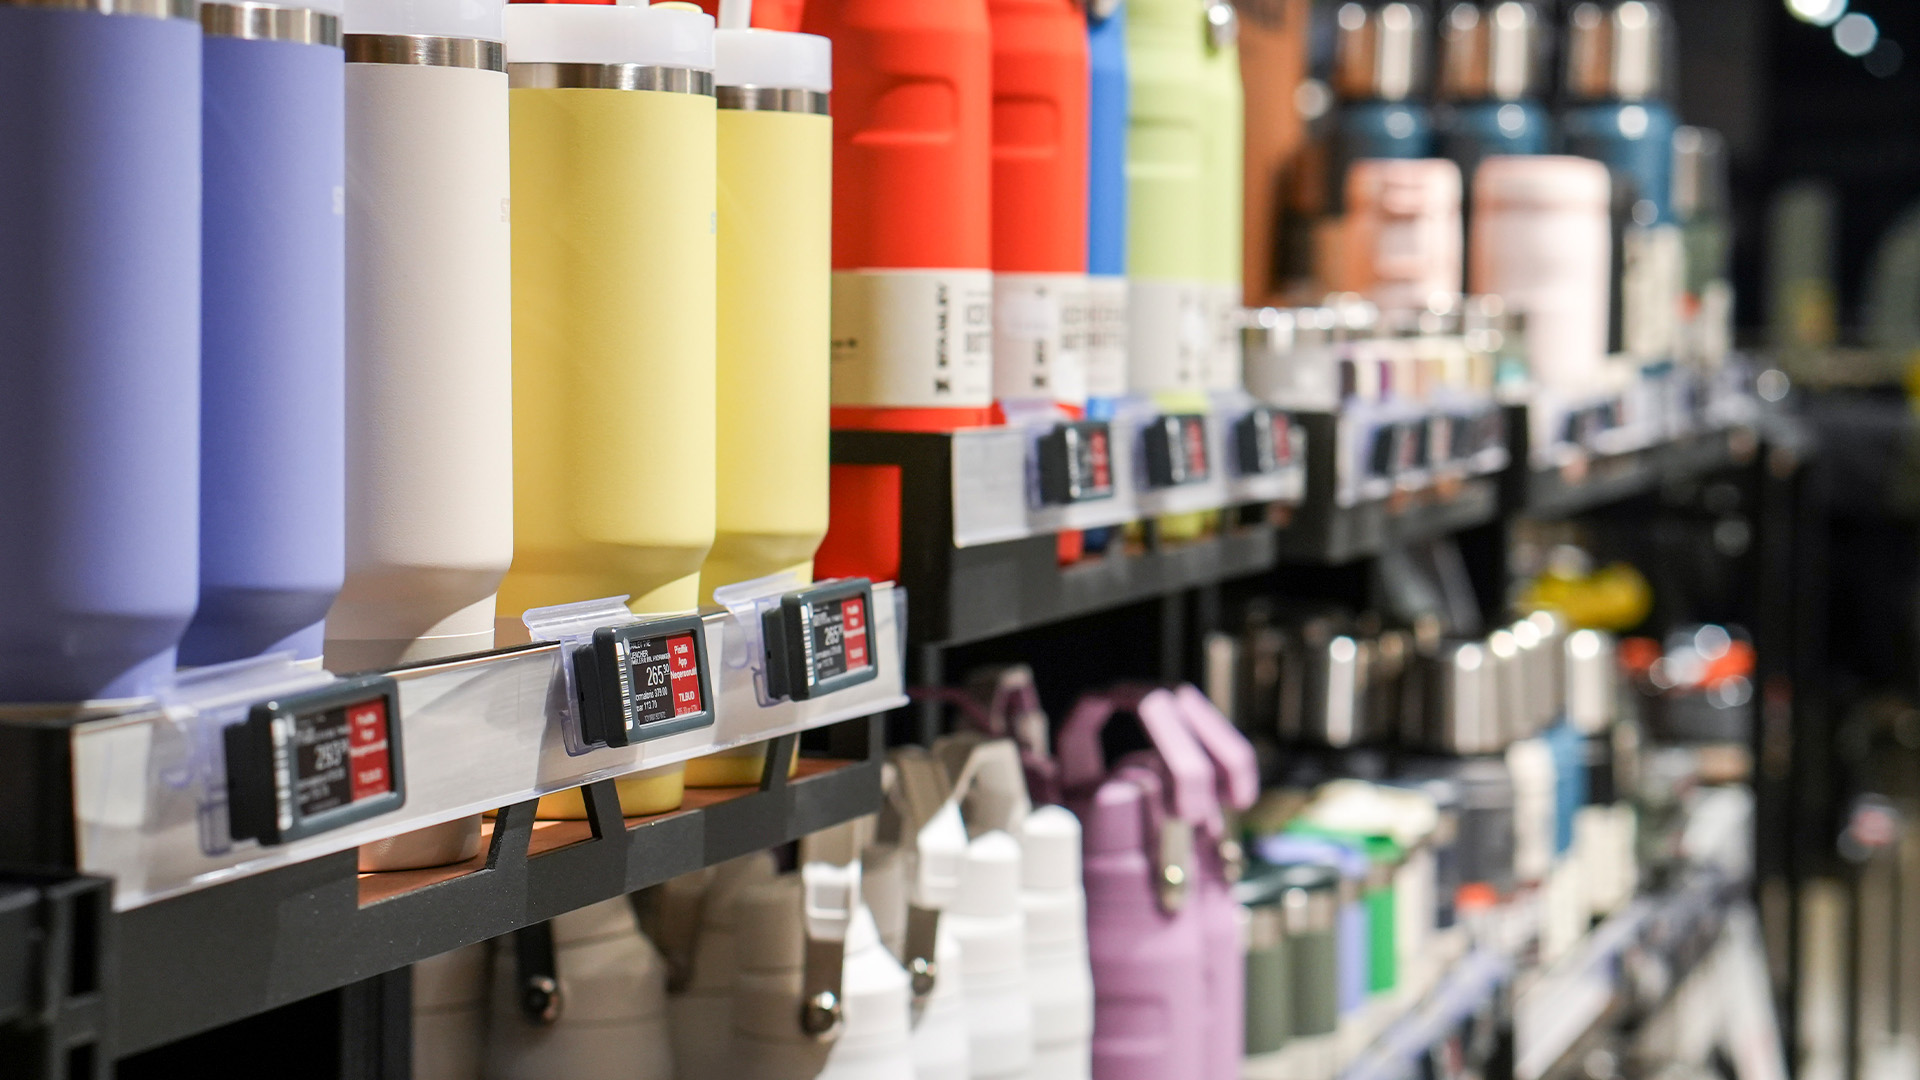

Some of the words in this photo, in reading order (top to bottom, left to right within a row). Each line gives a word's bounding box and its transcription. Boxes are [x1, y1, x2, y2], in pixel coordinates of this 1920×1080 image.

[678, 657, 688, 668] App
[646, 664, 664, 686] 265
[678, 691, 695, 702] TILBUD
